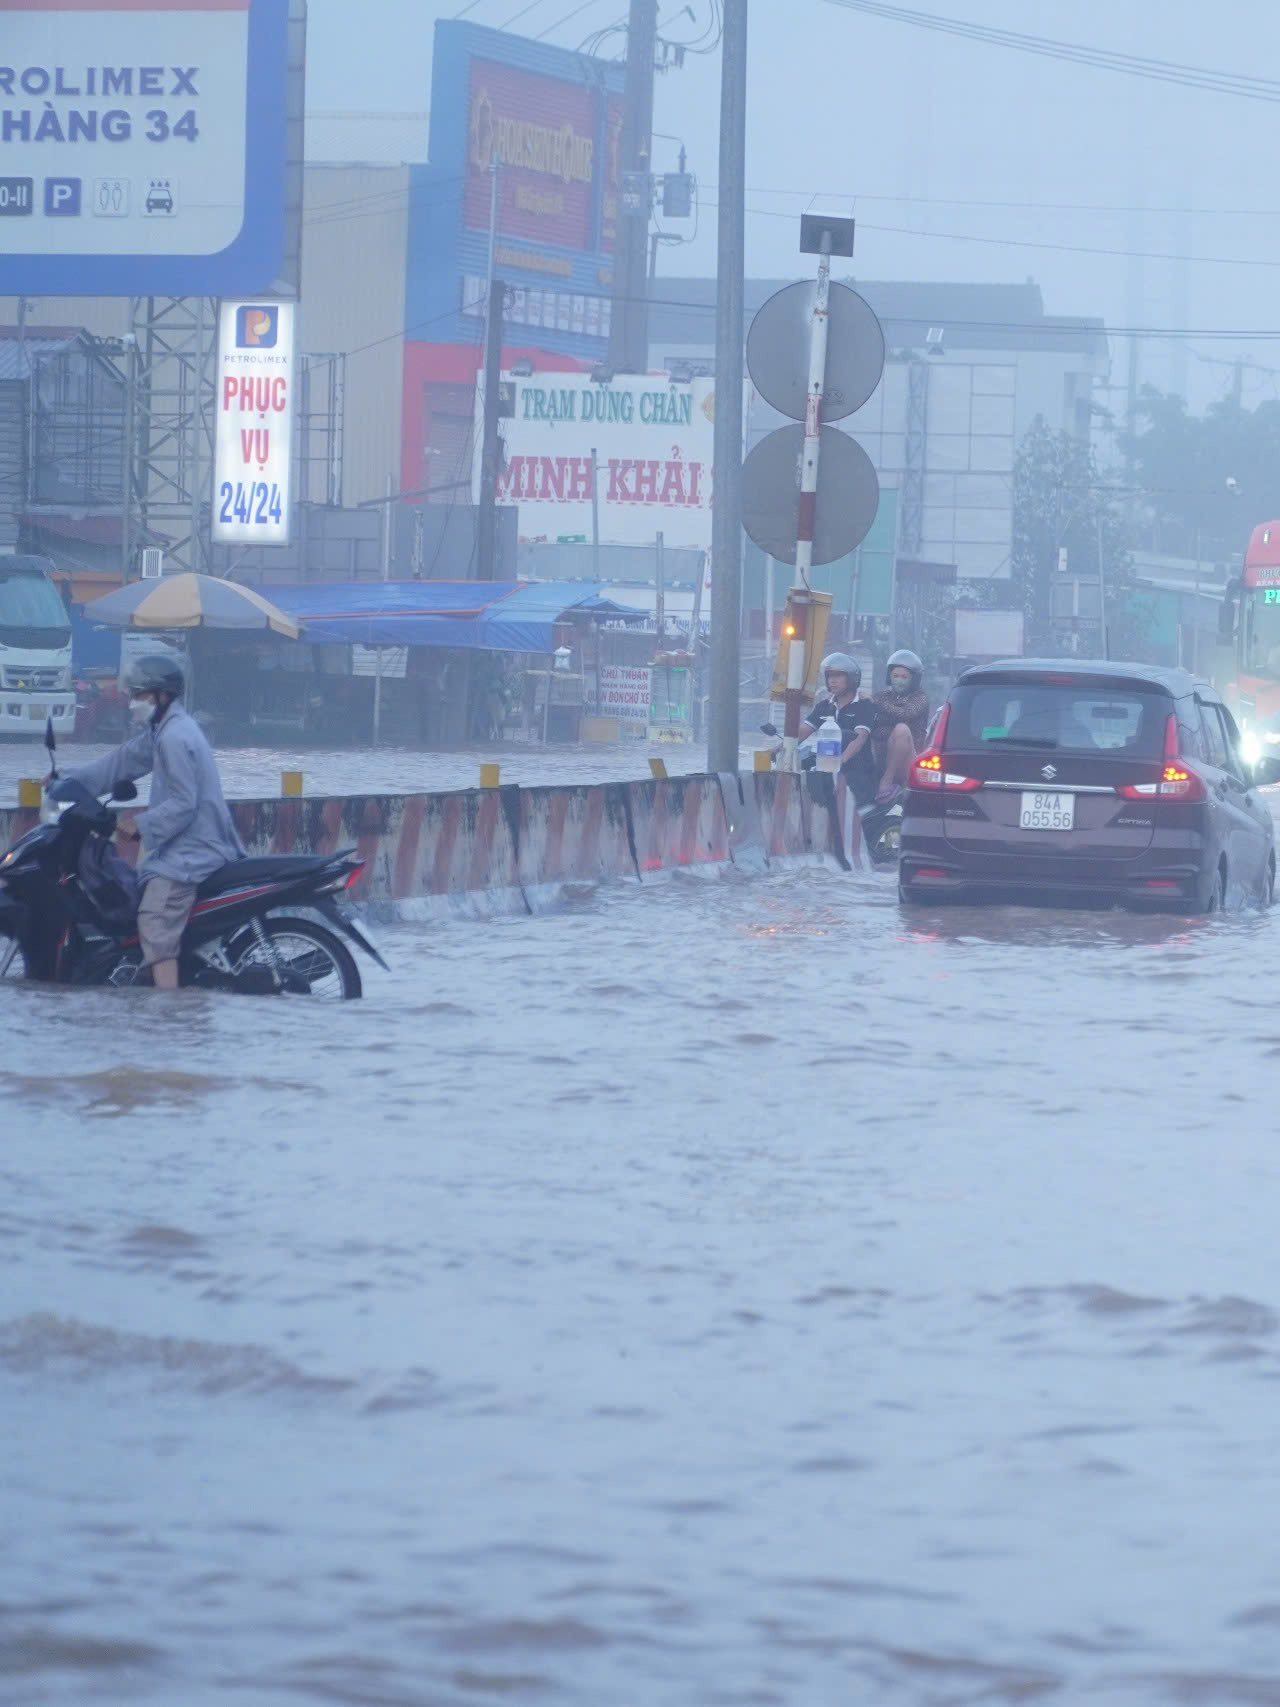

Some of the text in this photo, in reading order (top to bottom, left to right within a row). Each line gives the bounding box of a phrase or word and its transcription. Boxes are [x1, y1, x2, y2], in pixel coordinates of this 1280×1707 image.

[2, 101, 199, 142] HÀNG 34
[224, 355, 287, 364] PETROLIMEX
[223, 376, 287, 419] PHỤC
[639, 385, 693, 426] CHÂN
[240, 429, 269, 471] VỤ
[219, 481, 281, 524] 24/24
[1022, 810, 1071, 828] 055.56
[1034, 794, 1061, 810] 84A
